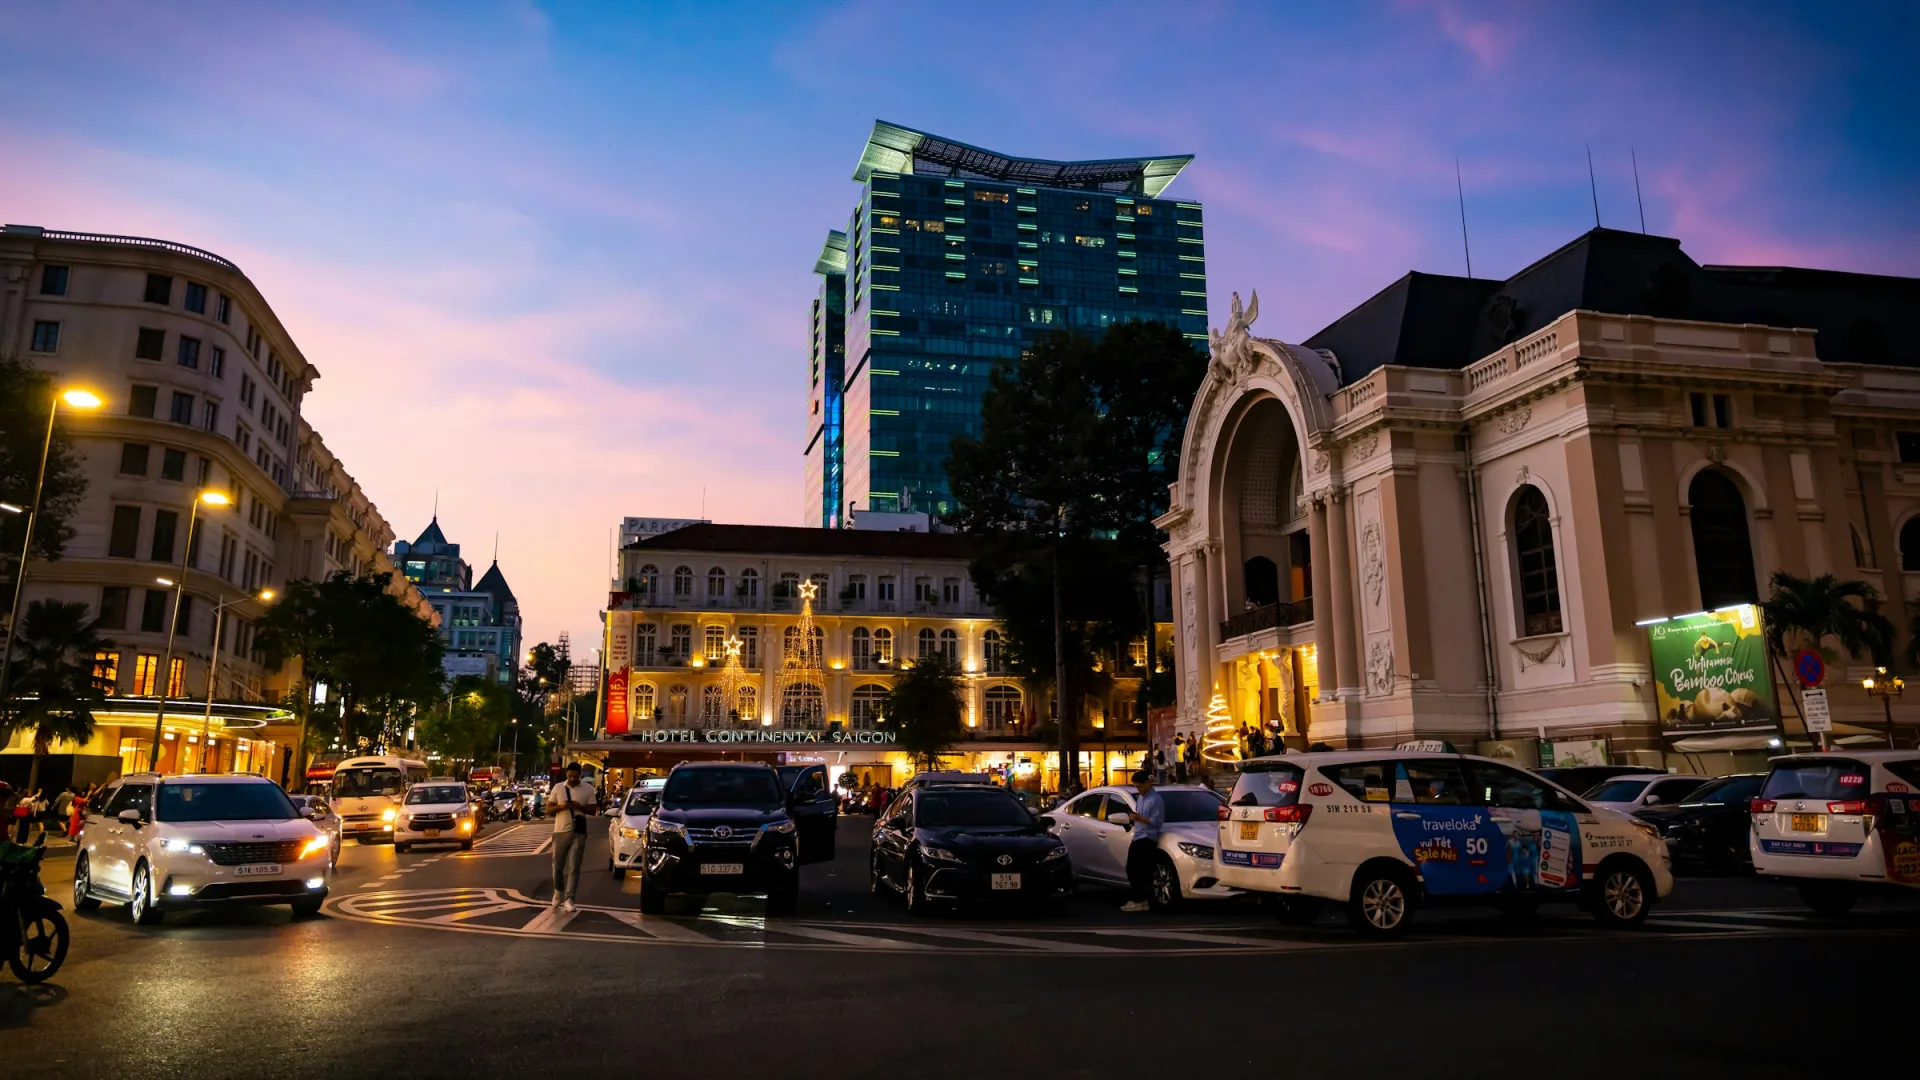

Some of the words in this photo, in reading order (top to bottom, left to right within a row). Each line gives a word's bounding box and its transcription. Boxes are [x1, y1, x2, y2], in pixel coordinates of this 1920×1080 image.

[1686, 655, 1733, 672] Vietnamese
[1670, 668, 1724, 692] Bamboo
[1725, 668, 1754, 685] Circus
[641, 730, 698, 743] HOTEL
[706, 730, 824, 743] CONTINENTAL
[832, 731, 896, 744] SAIGON
[1310, 785, 1332, 794] 10760
[1422, 818, 1477, 831] traveloka
[1415, 848, 1439, 861] Sale
